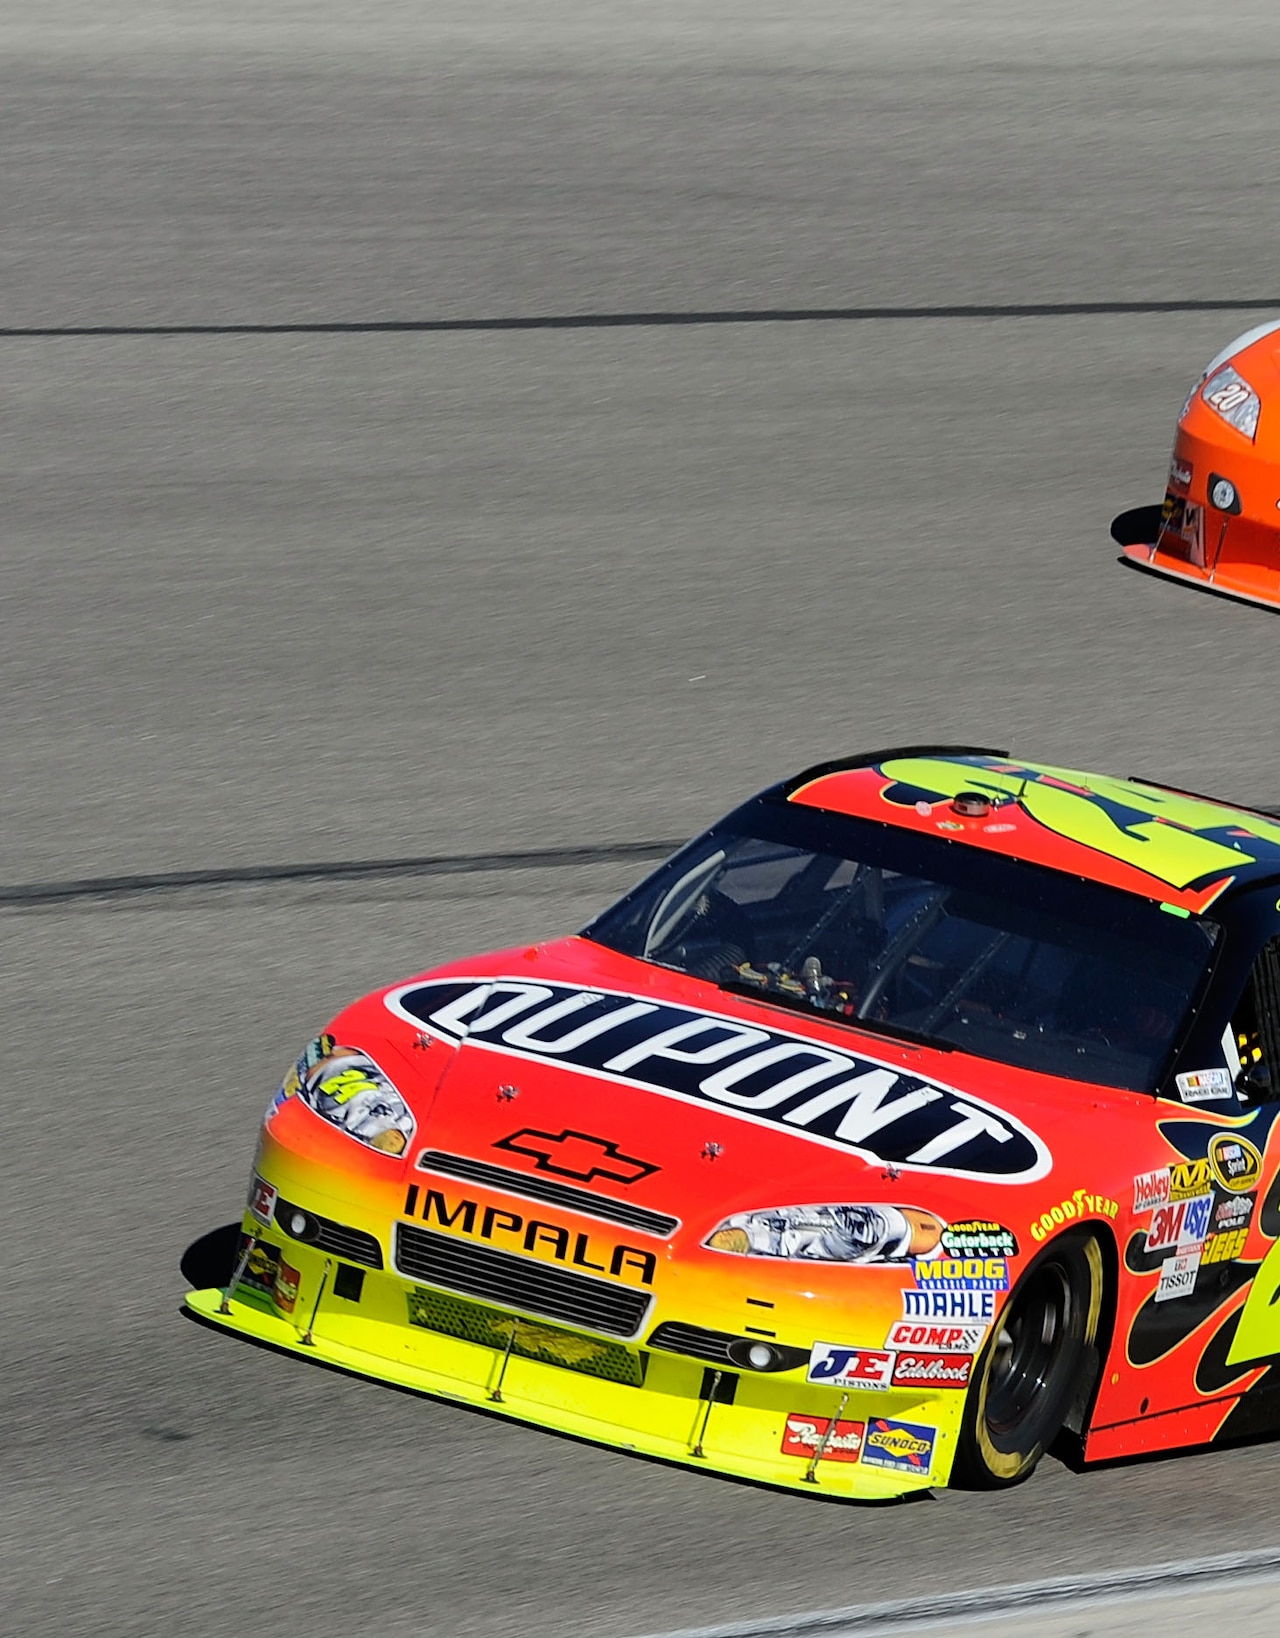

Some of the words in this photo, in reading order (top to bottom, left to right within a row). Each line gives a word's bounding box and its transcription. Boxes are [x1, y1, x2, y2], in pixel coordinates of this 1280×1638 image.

[1209, 382, 1250, 412] 20
[318, 1068, 378, 1105] 24
[1135, 1172, 1170, 1201] Holley
[947, 1220, 1001, 1233] GOODYEAR
[1030, 1188, 1119, 1242] GOODYEAR
[1149, 1202, 1186, 1247] 3M
[1183, 1197, 1211, 1240] USG
[1217, 1215, 1245, 1230] POLE
[403, 1183, 657, 1286] IMPALA
[941, 1231, 1014, 1249] Gatorback
[915, 1258, 1005, 1280] MOOG
[1160, 1270, 1196, 1291] TISSOT
[904, 1292, 994, 1317] MAHLE
[892, 1325, 964, 1345] COMP
[810, 1350, 891, 1381] JE
[895, 1357, 970, 1382] Edelbrock
[833, 1377, 889, 1390] PISTONS
[869, 1433, 931, 1453] SUNOCO
